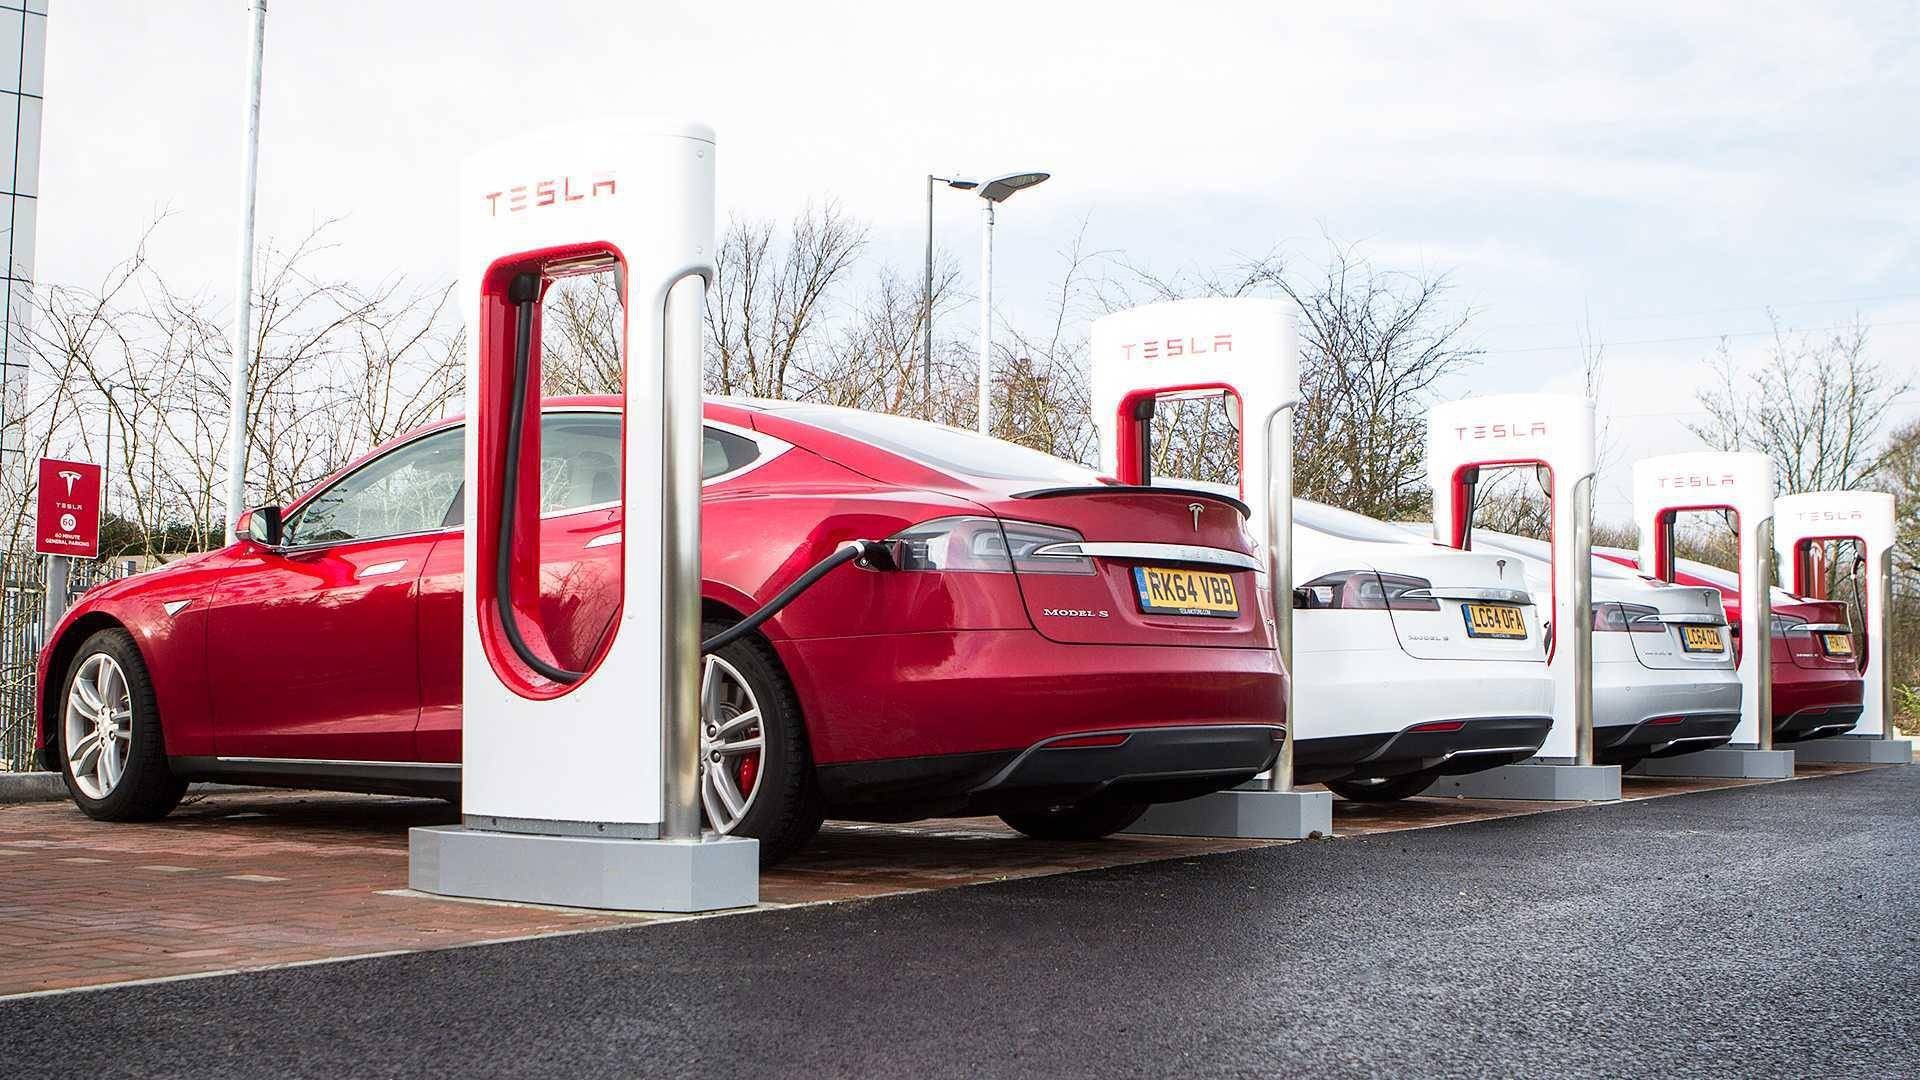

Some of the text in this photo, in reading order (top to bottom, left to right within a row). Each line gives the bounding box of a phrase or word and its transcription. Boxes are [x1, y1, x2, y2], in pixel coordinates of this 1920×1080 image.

[485, 174, 616, 217] TESLA
[1120, 333, 1233, 361] TESLA
[1453, 422, 1546, 441] TESLA
[1656, 473, 1735, 489] TESLA
[56, 502, 82, 510] TESLA
[62, 518, 74, 527] 60
[1794, 510, 1863, 521] TESLA
[1148, 570, 1234, 606] RK64 VBB
[1043, 608, 1109, 618] MODEL S
[1470, 607, 1524, 631] LC64 OFA
[1686, 628, 1707, 645] LC64
